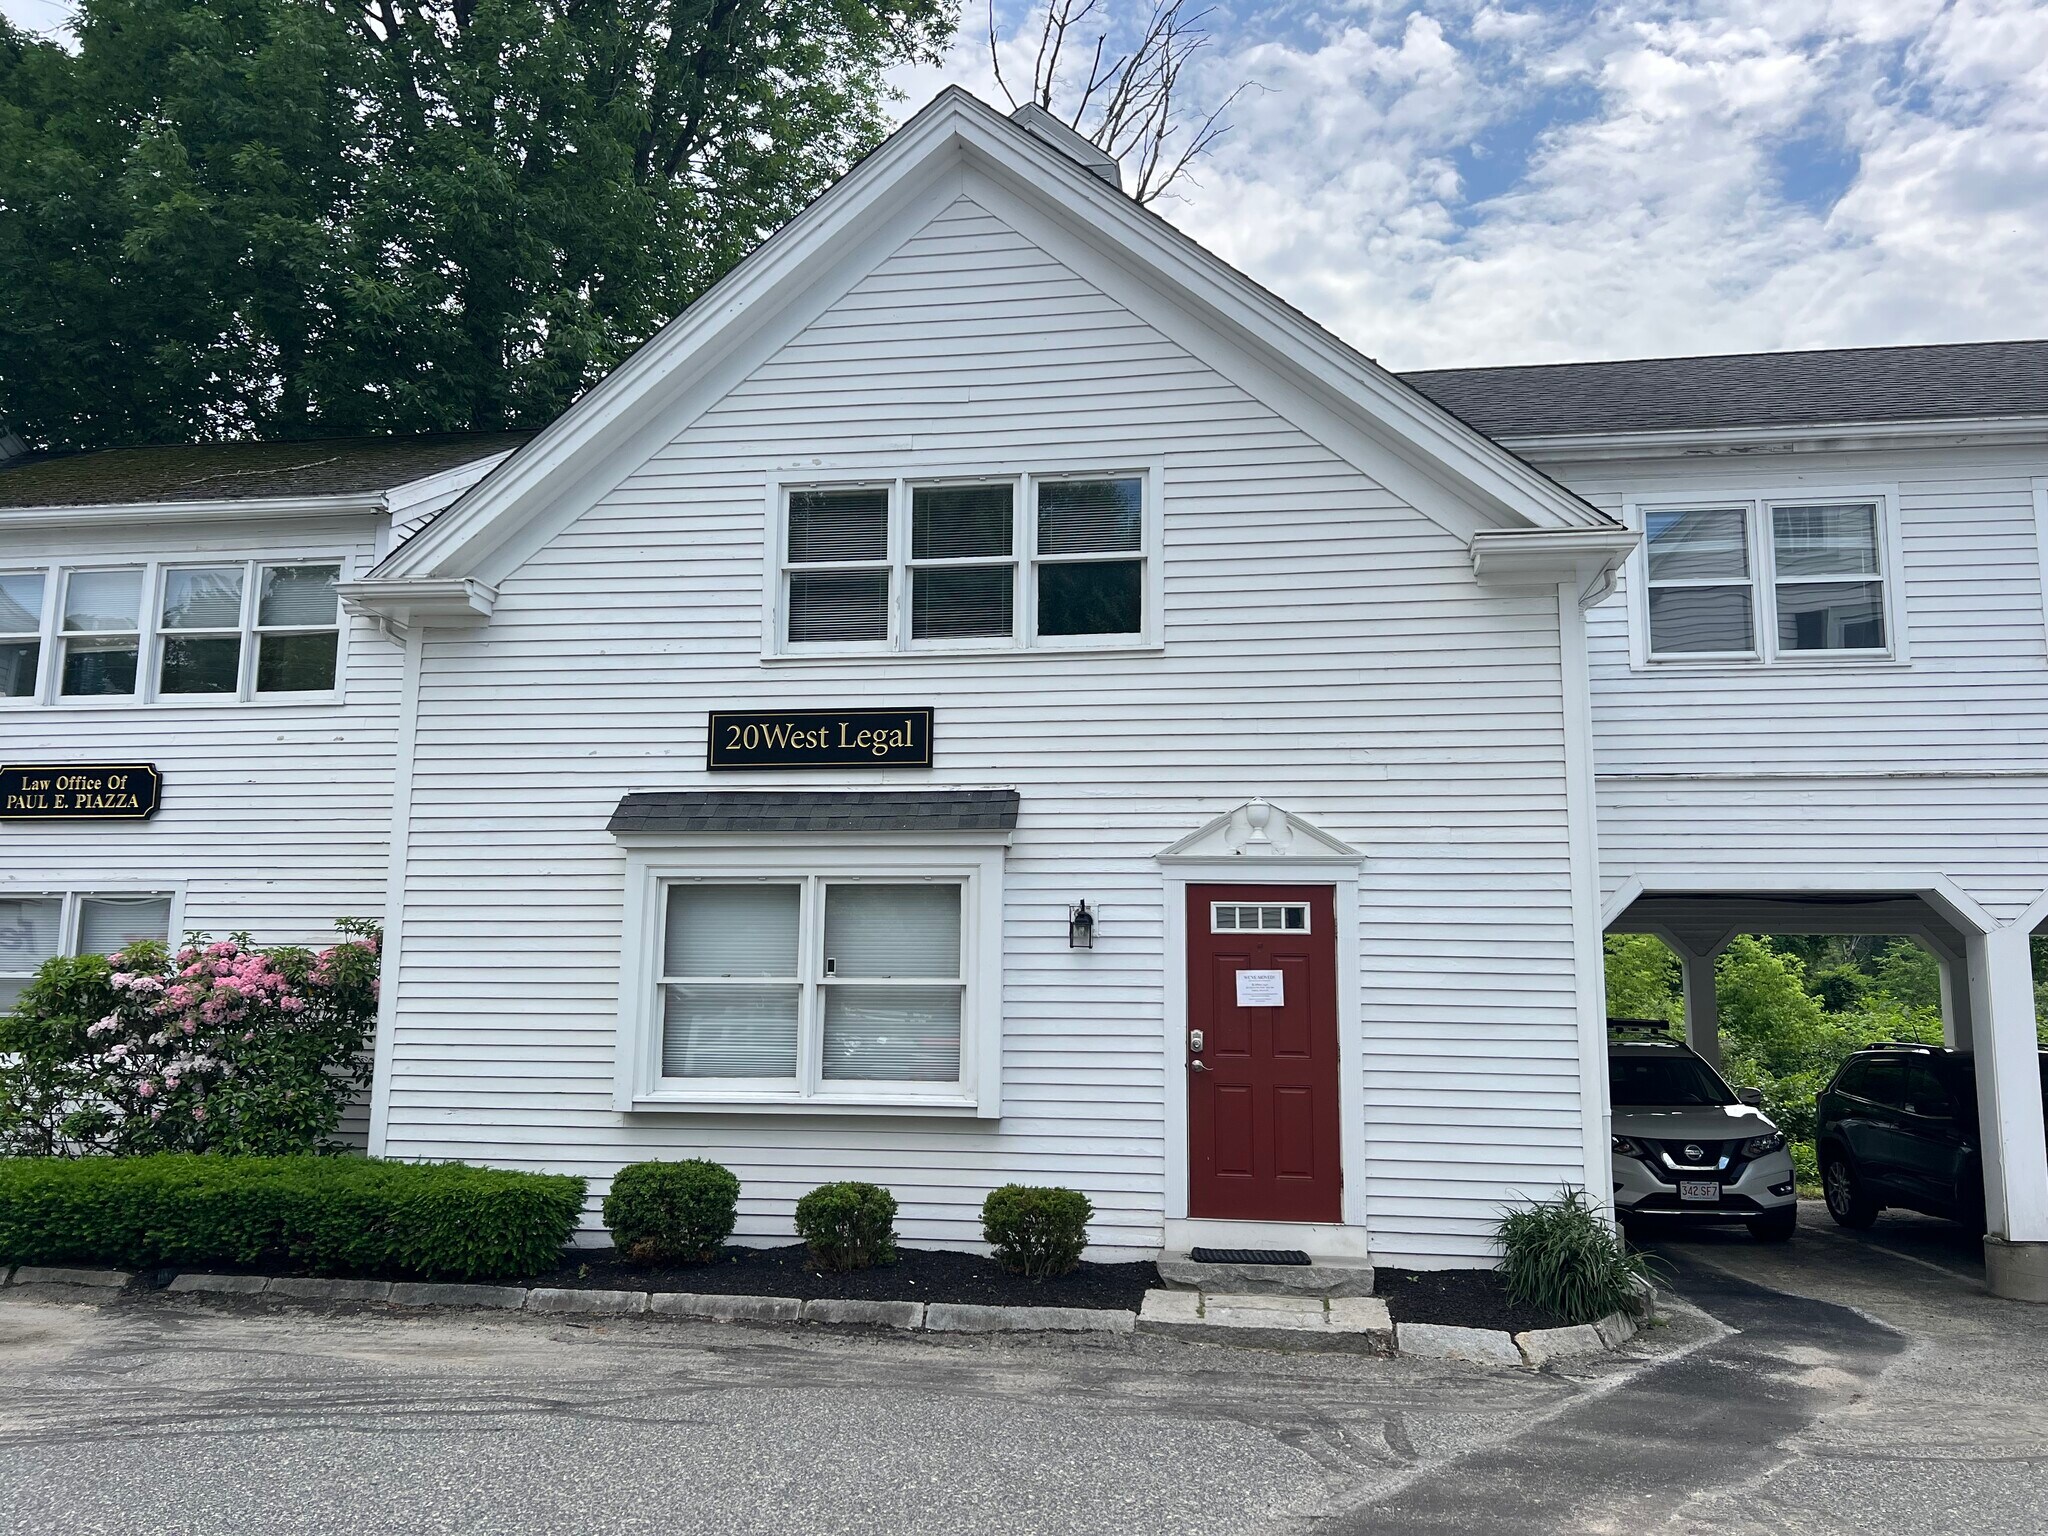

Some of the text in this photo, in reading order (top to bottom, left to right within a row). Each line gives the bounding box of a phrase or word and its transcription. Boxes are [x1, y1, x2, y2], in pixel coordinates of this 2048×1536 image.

[725, 719, 914, 756] 20West Legal
[21, 774, 128, 791] Law Office Of
[6, 793, 139, 809] PAUL E. PIAZZA
[1682, 1186, 1717, 1196] 342 SF7
